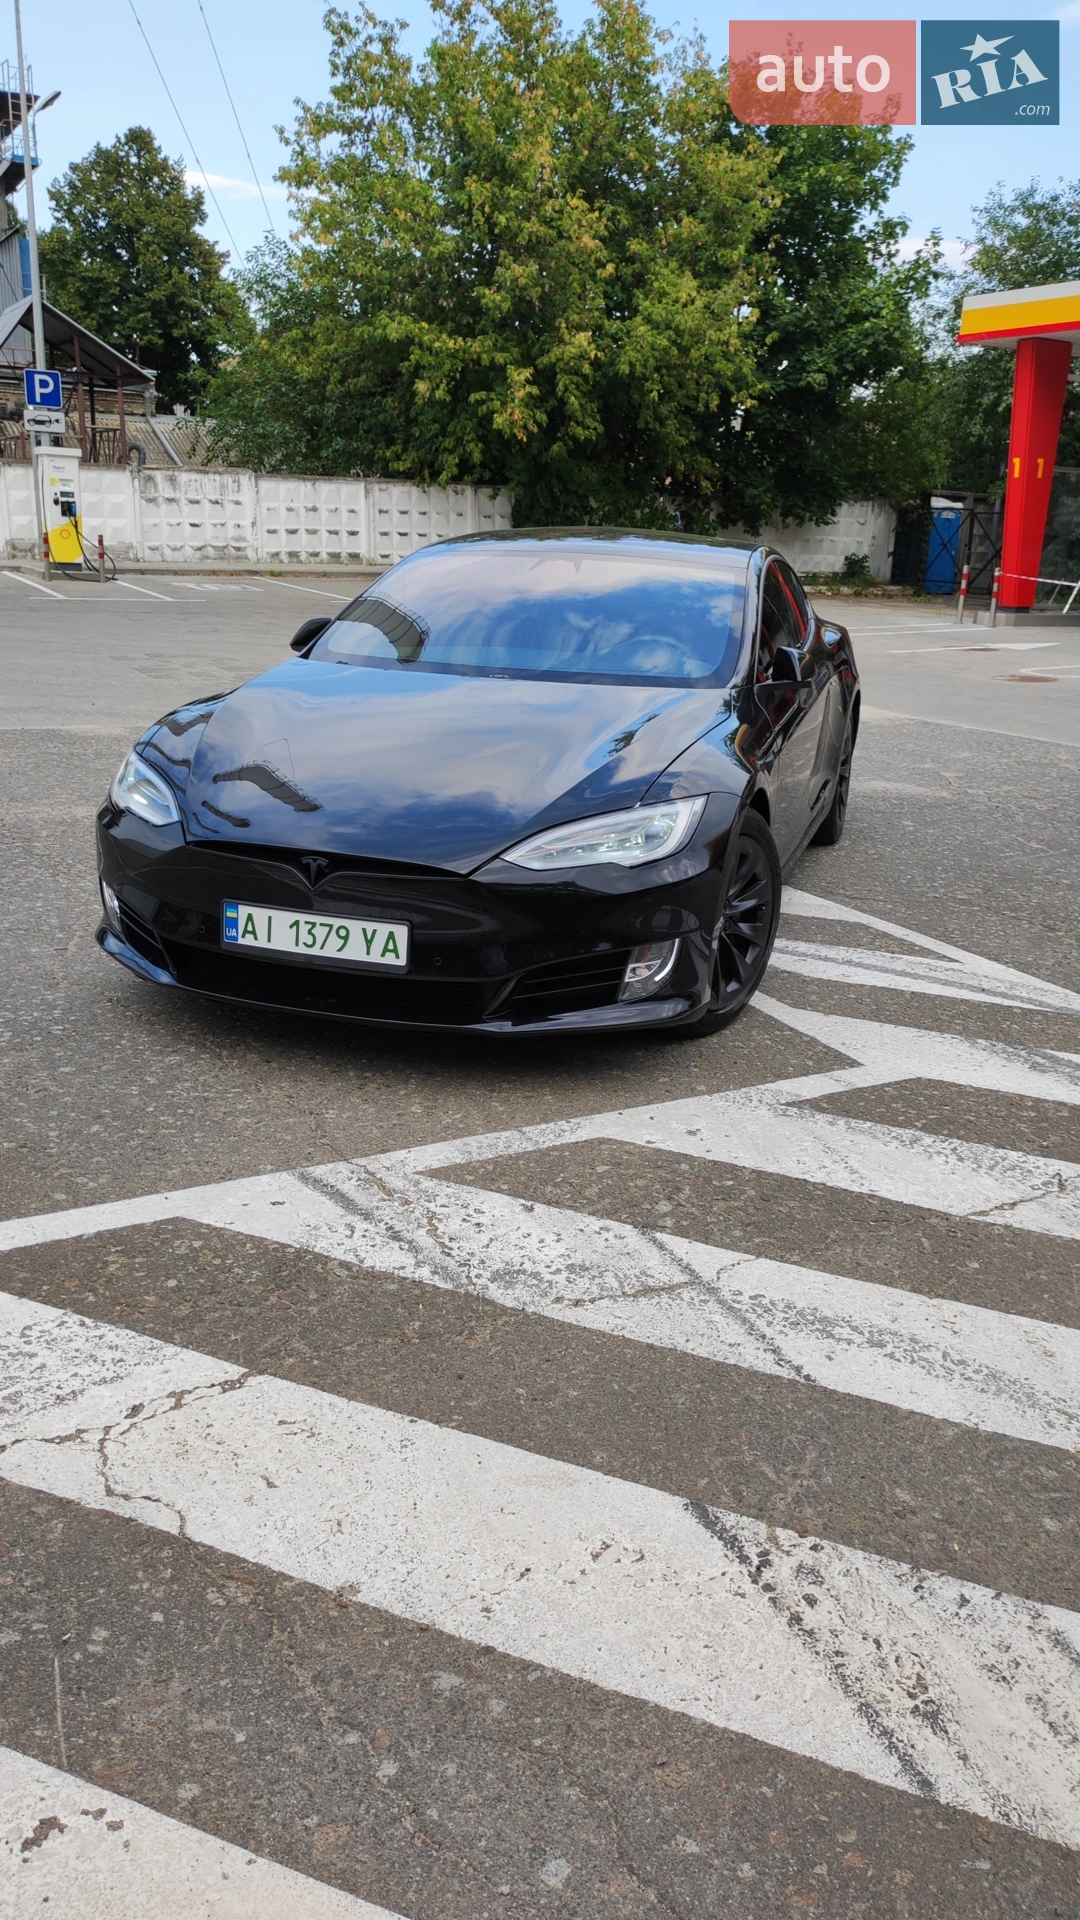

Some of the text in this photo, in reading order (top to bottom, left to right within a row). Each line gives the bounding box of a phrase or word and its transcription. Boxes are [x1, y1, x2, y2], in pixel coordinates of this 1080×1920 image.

[34, 373, 55, 403] P
[1013, 457, 1020, 478] 1
[1037, 458, 1044, 478] 1
[226, 927, 237, 937] UA
[241, 913, 400, 959] AI 1379 YA
